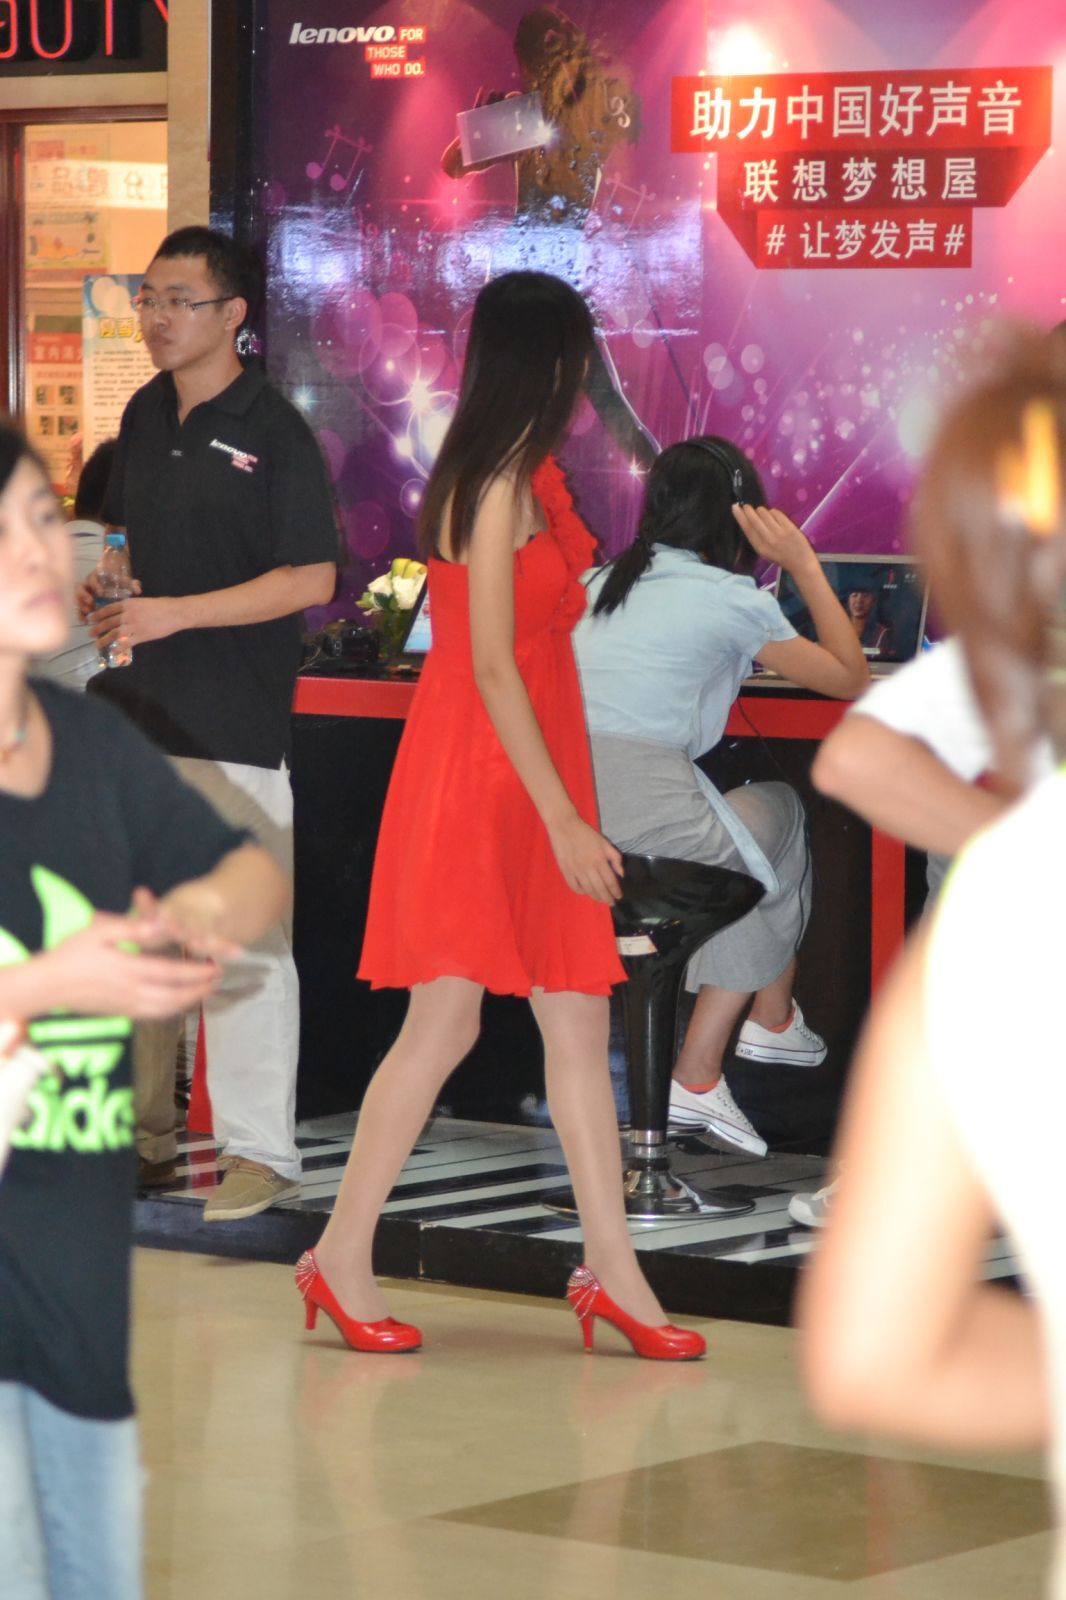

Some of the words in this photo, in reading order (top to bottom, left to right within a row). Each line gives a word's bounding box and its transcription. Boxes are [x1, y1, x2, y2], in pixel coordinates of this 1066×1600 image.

[289, 22, 395, 45] lenovo
[400, 28, 423, 41] FOR
[367, 46, 405, 58] THOSE
[373, 63, 400, 76] WHO
[404, 63, 424, 76] DO.
[690, 80, 1022, 140] 助力中国好声音
[743, 156, 978, 203] 联想梦想屋
